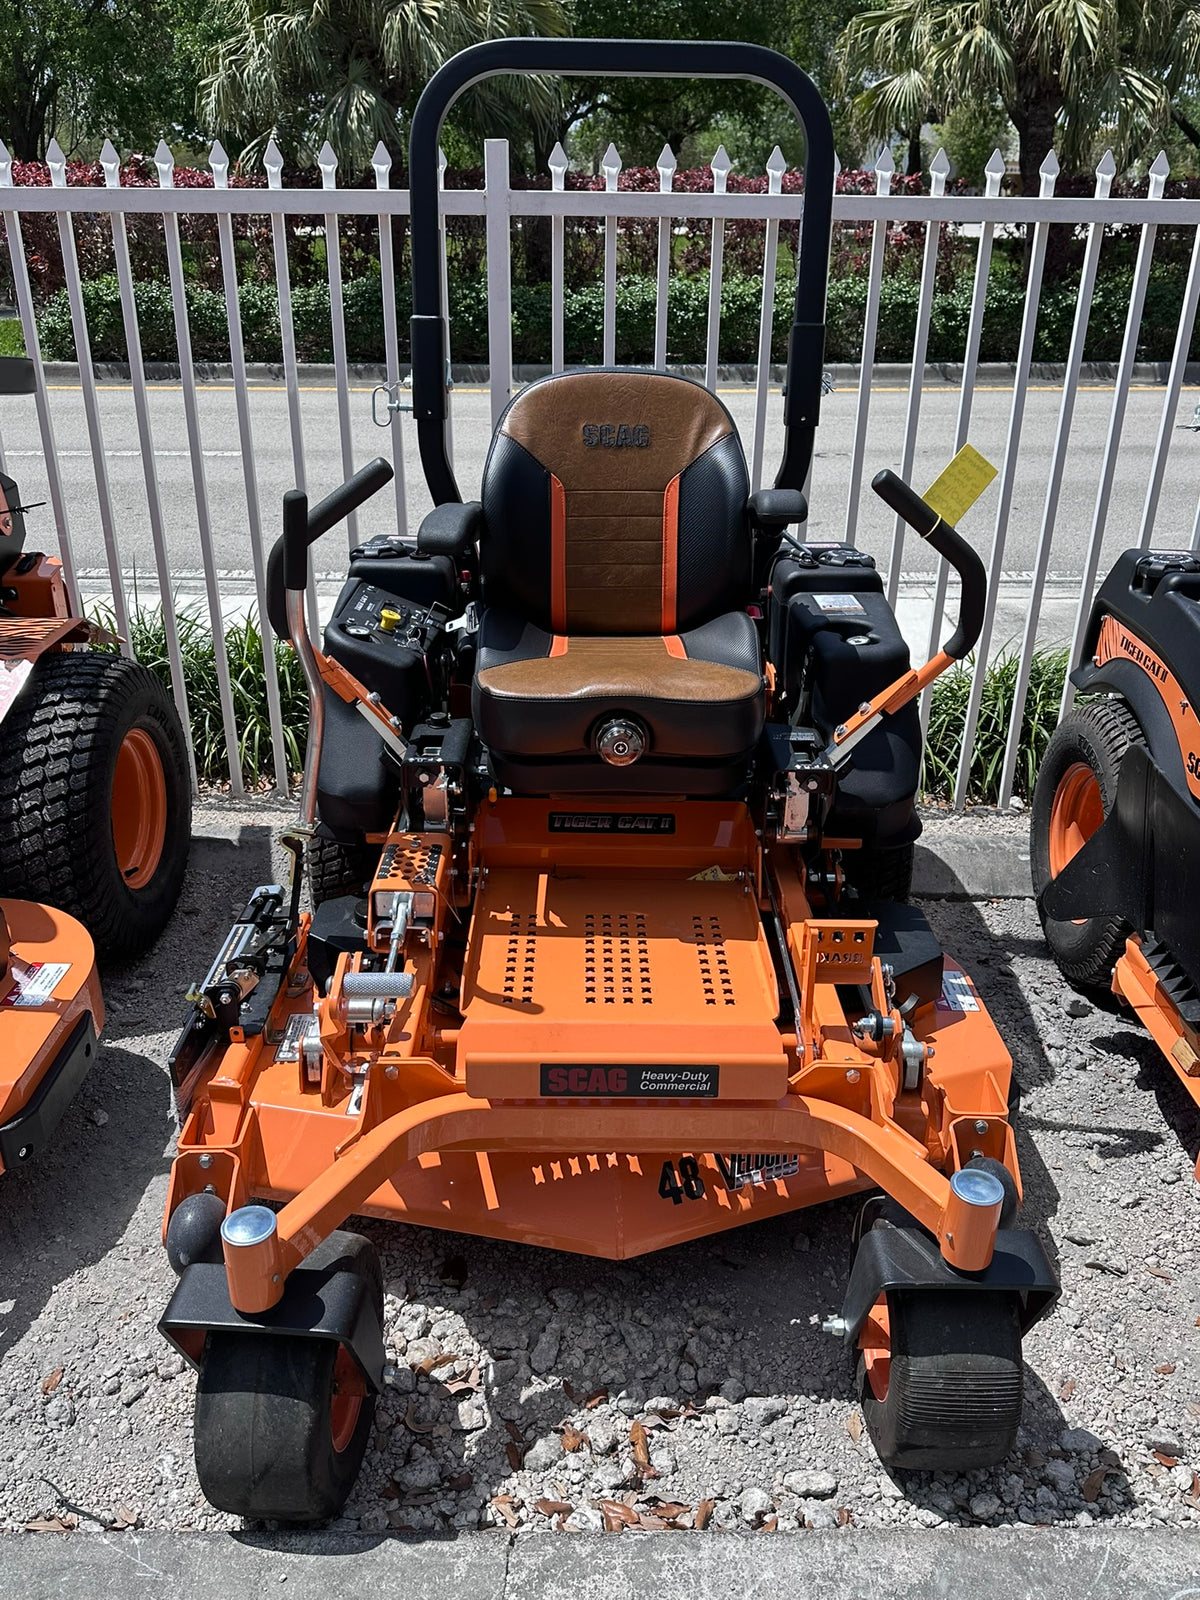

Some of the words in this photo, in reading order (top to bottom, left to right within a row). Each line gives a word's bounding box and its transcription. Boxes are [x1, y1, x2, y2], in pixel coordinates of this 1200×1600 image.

[582, 424, 649, 448] SCAG
[1120, 634, 1144, 663] TIGER
[1143, 655, 1164, 678] CAT
[552, 815, 613, 828] TIGER
[617, 816, 658, 829] CAT
[660, 817, 672, 828] II
[548, 1067, 628, 1093] SCAG
[639, 1081, 711, 1091] Commercial
[641, 1070, 710, 1083] Heavy-Duty
[658, 1155, 706, 1205] 48
[713, 1153, 799, 1190] VELOC
